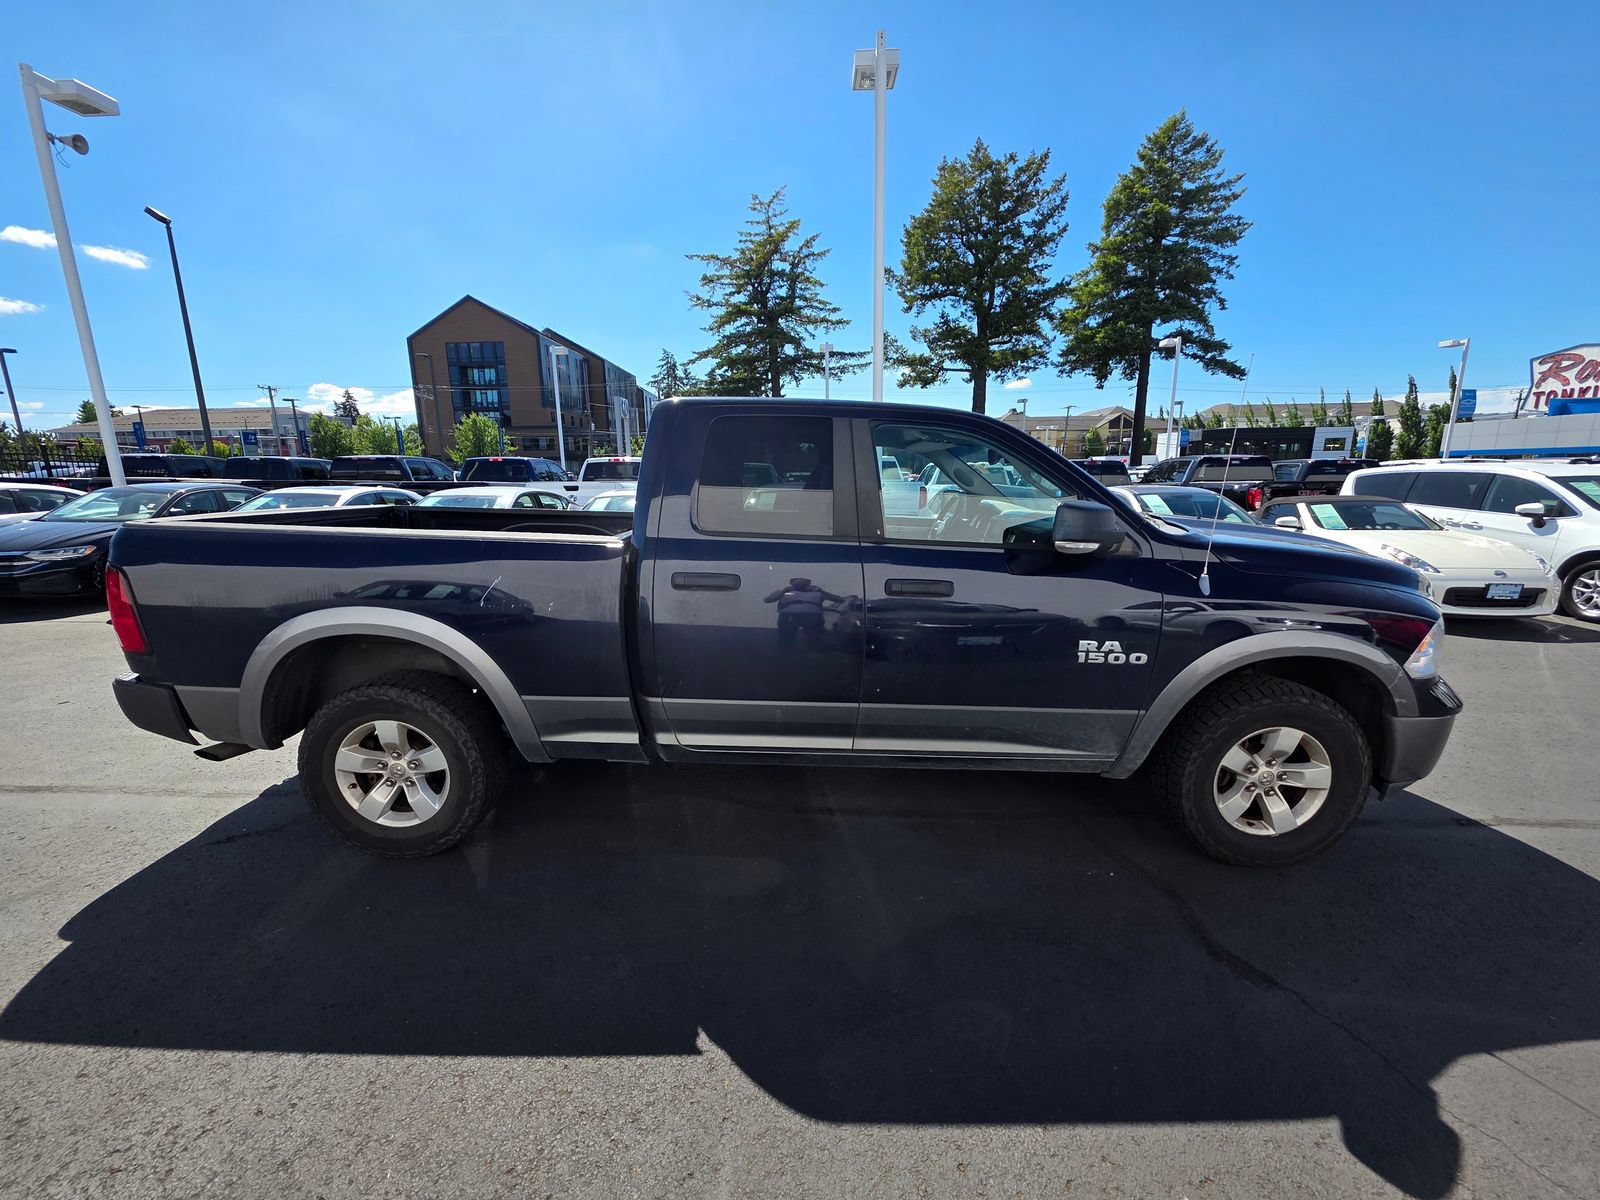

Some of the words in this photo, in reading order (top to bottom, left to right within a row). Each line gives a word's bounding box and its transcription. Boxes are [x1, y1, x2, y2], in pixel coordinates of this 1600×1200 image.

[1535, 353, 1600, 389] Ro
[1078, 639, 1123, 652] RA
[1077, 652, 1149, 665] 1500
